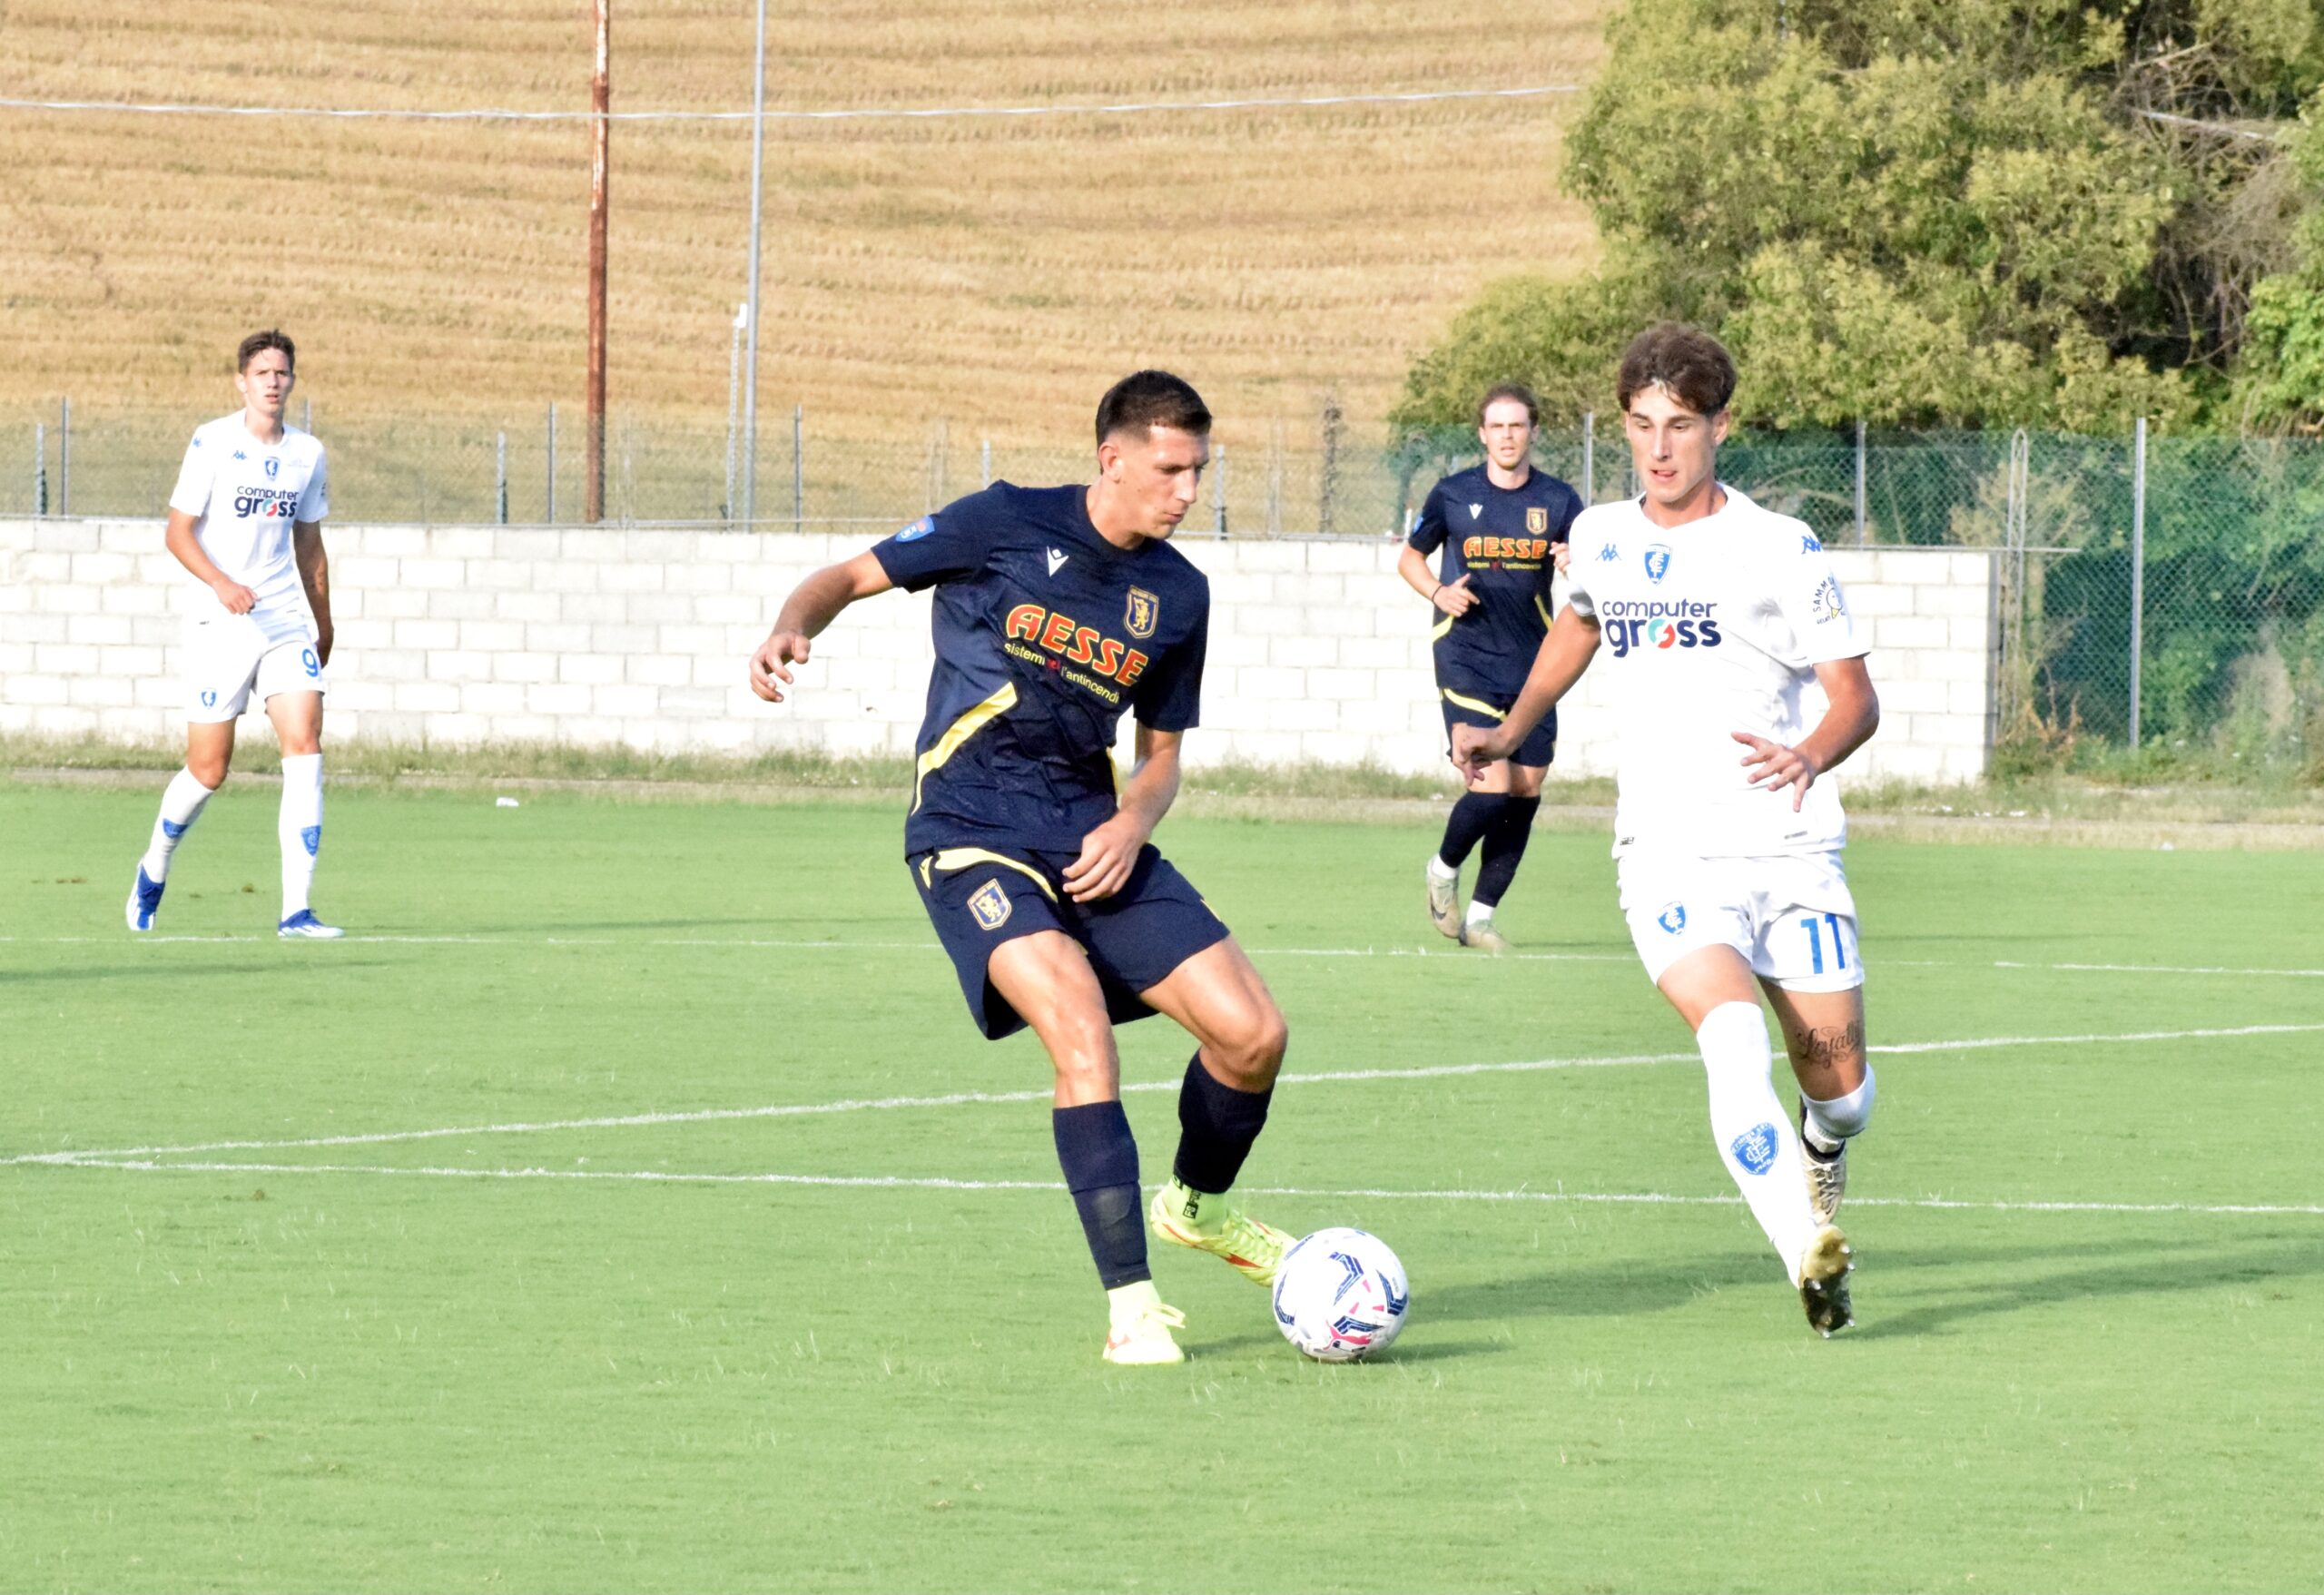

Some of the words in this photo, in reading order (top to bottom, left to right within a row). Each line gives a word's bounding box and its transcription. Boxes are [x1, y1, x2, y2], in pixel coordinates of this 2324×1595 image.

[236, 485, 300, 501] computer
[234, 496, 298, 518] gross
[1462, 536, 1548, 559] AESSE
[1602, 598, 1718, 618] computer
[1005, 604, 1149, 686] AESSE
[1604, 618, 1722, 658] gross
[301, 648, 320, 678] 9
[1003, 641, 1046, 666] sistemi
[1800, 912, 1846, 975] 11
